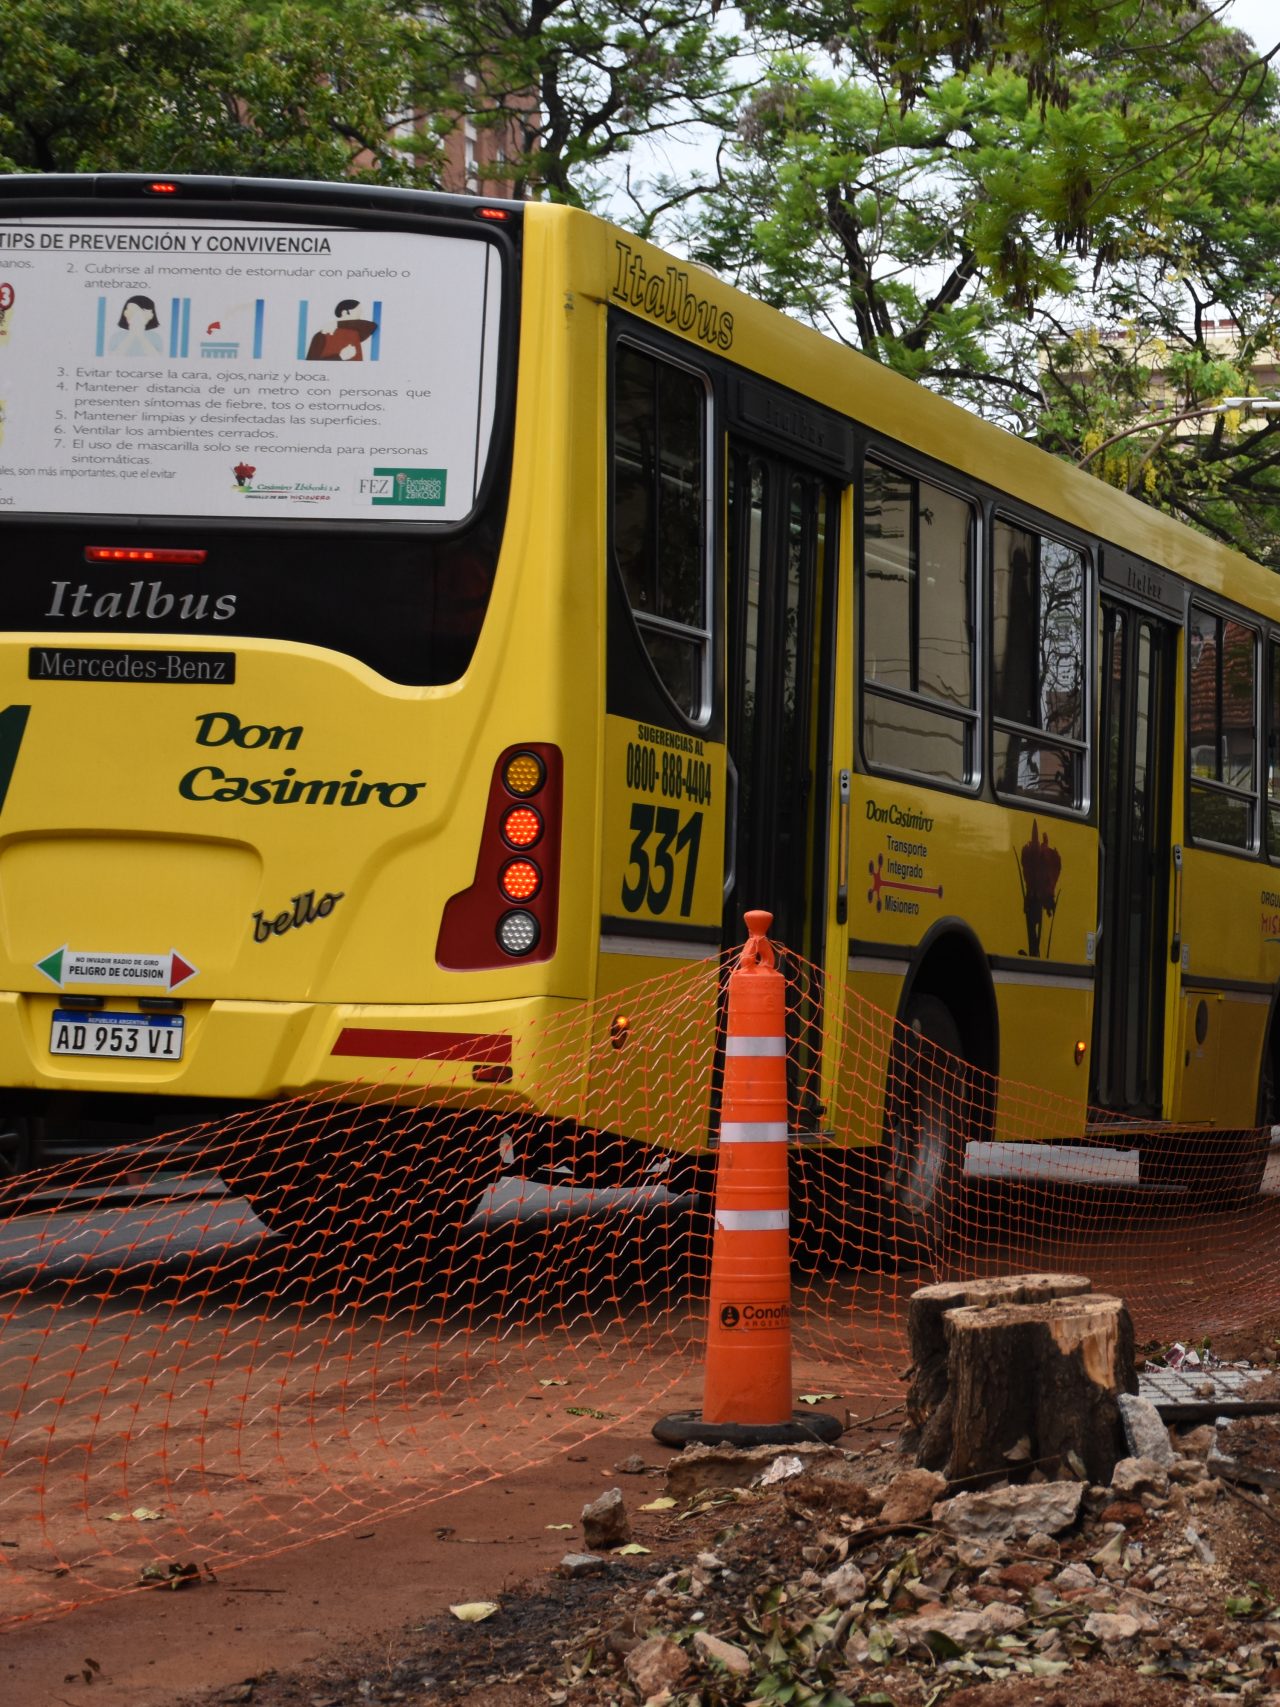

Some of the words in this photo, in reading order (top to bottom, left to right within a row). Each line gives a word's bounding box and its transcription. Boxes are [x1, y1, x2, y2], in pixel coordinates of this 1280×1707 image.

[40, 233, 64, 249] DE
[69, 232, 187, 251] PREVENCIÓN
[192, 236, 202, 251] Y
[206, 236, 332, 253] CONVIVENCIA
[0, 259, 35, 269] anos.
[66, 262, 78, 273] 2.
[84, 263, 140, 275] Cubrirse
[143, 265, 154, 275] al
[158, 266, 222, 276] momento
[225, 266, 241, 276] de
[246, 266, 313, 277] estornudar
[319, 268, 343, 277] con
[347, 267, 397, 280] pañuelo
[401, 270, 411, 278] o
[84, 278, 151, 289] antebrazo.
[612, 240, 734, 351] Italbus
[56, 367, 69, 377] 3.
[75, 367, 112, 378] Evitar
[116, 368, 163, 378] tocarse
[167, 369, 178, 379] la
[283, 374, 290, 383] y
[295, 371, 330, 382] boca.
[55, 382, 68, 392] 4.
[75, 382, 139, 393] Mantener
[146, 383, 201, 394] distancia
[208, 384, 226, 394] de
[233, 386, 250, 395] un
[258, 385, 299, 396] metro
[306, 387, 331, 396] con
[339, 388, 399, 398] personas
[406, 389, 432, 398] que
[74, 398, 140, 408] presenten
[144, 398, 201, 409] síntomas
[204, 399, 222, 409] de
[271, 401, 291, 410] tos
[295, 402, 304, 410] o
[308, 401, 385, 412] estornudos.
[55, 410, 67, 421] 5.
[73, 410, 138, 422] Mantener
[141, 411, 185, 424] limpias
[188, 415, 196, 424] y
[200, 413, 286, 425] desinfectadas
[289, 415, 306, 425] las
[310, 415, 382, 427] superficies.
[54, 424, 66, 434] 6.
[73, 424, 122, 435] Ventilar
[125, 425, 144, 436] los
[149, 426, 214, 437] ambientes
[218, 427, 279, 438] cerrados.
[53, 438, 65, 449] 7.
[72, 439, 84, 449] El
[88, 441, 112, 450] uso
[116, 440, 133, 450] de
[137, 440, 199, 452] mascarilla
[203, 442, 231, 452] solo
[235, 444, 250, 453] se
[254, 443, 332, 454] recomienda
[336, 446, 365, 456] para
[369, 446, 429, 456] personas
[18, 468, 36, 476] son
[38, 467, 57, 477] más
[119, 470, 138, 480] que
[140, 468, 149, 478] el
[150, 469, 177, 479] evitar
[406, 477, 441, 486] Fundación
[360, 479, 389, 494] FEZ
[406, 485, 441, 493] EDUARDO
[45, 581, 238, 621] Italbus
[39, 652, 226, 681] Mercedes-Benz
[195, 712, 304, 751] Don
[637, 724, 694, 754] SUGERENCIAS
[693, 740, 704, 756] AL
[178, 765, 426, 808] Casimiro
[886, 834, 928, 858] Transporte
[621, 802, 704, 918] 331
[887, 858, 923, 880] Integrado
[884, 894, 919, 916] Misionero
[252, 888, 345, 944] bello
[69, 965, 107, 977] PELIGRO
[108, 967, 120, 977] DE
[122, 967, 164, 979] COLISION
[56, 1025, 87, 1050] AD
[95, 1026, 140, 1053] 953
[148, 1029, 174, 1055] VI
